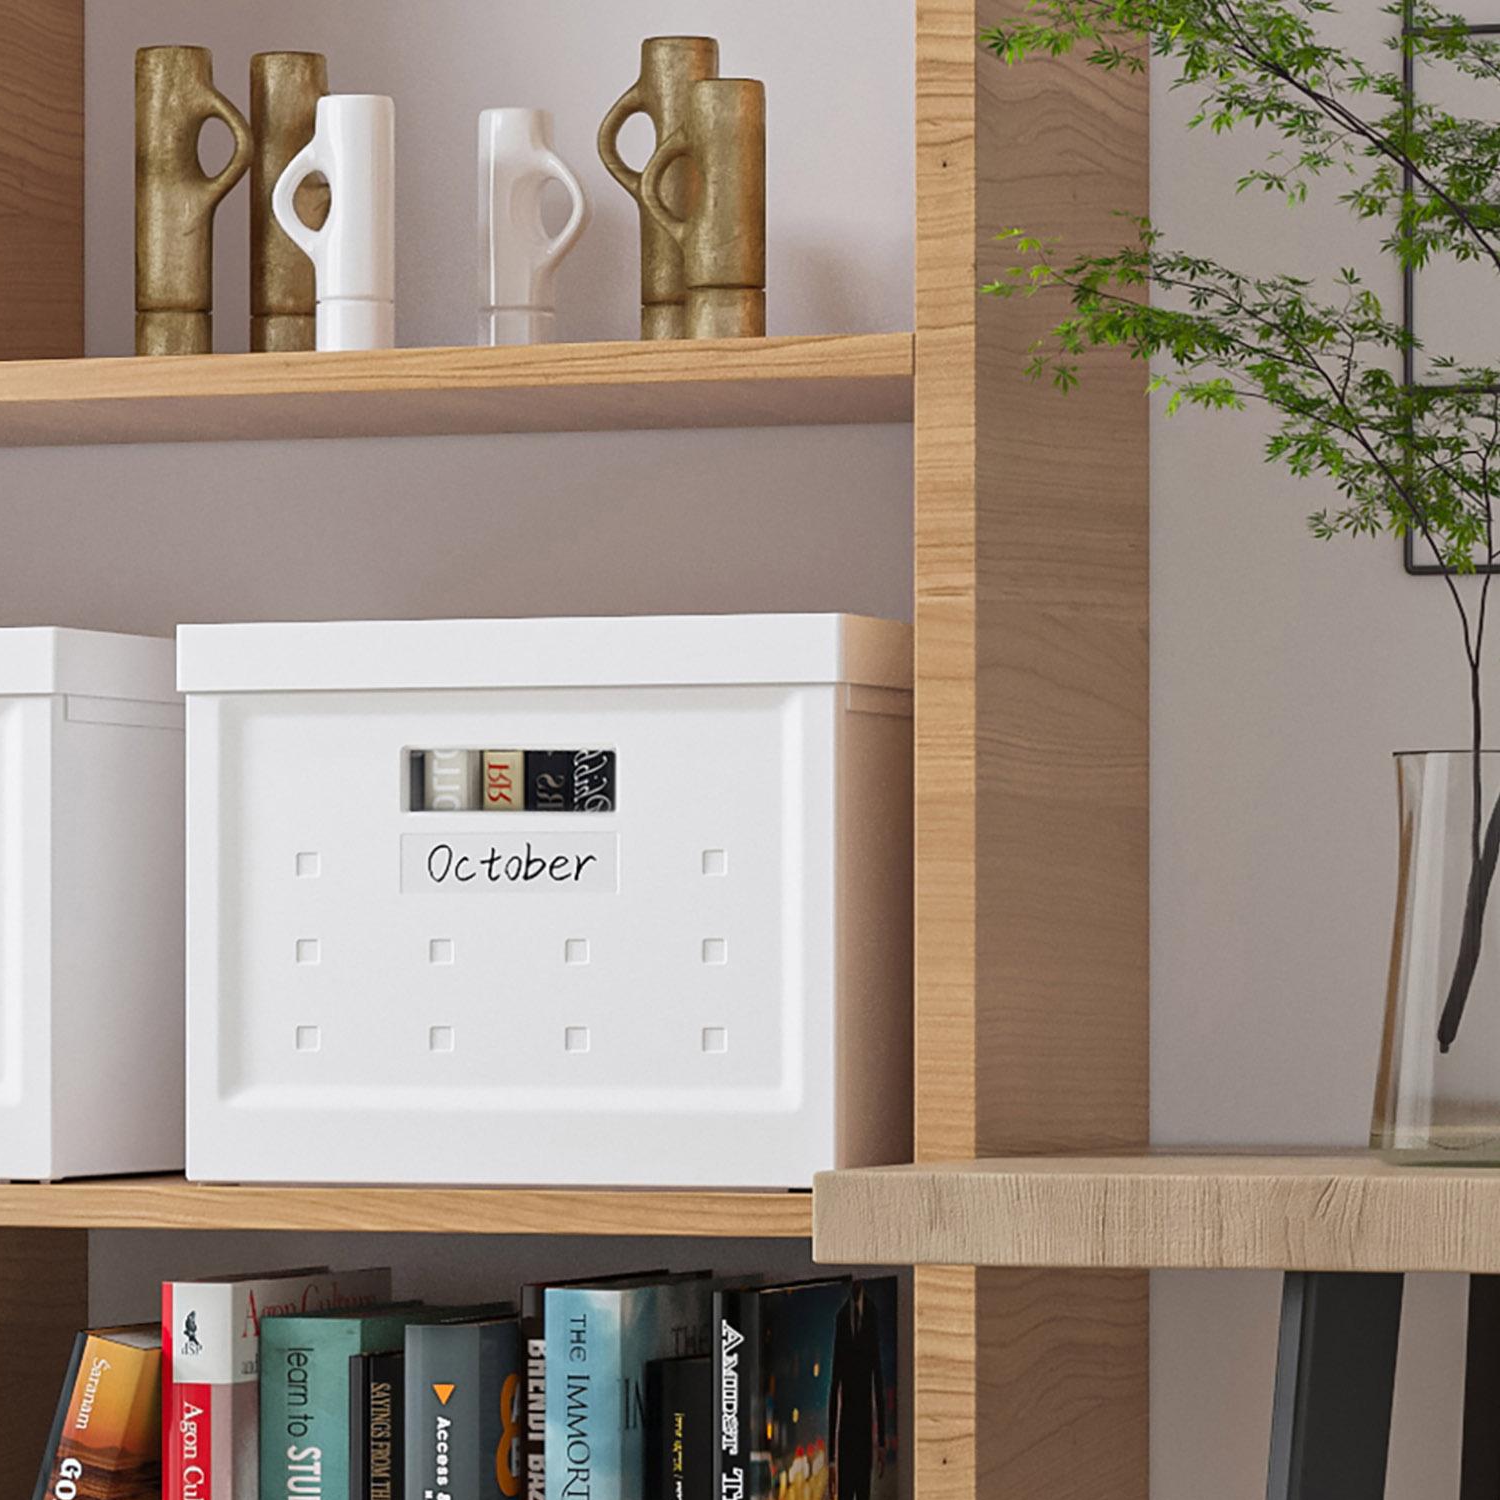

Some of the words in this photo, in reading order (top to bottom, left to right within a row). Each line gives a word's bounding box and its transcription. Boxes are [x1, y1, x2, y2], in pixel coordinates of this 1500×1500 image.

[428, 842, 597, 883] October
[570, 1314, 587, 1363] THE
[75, 1357, 111, 1429] Saranam
[287, 1347, 314, 1407] learn
[527, 1339, 546, 1440] BHENDI
[722, 1319, 745, 1455] AMIDST
[180, 1401, 204, 1459] Agon
[287, 1415, 314, 1438] to
[371, 1382, 392, 1438] SAYINGS
[371, 1441, 392, 1478] FROM
[436, 1416, 451, 1485] Access
